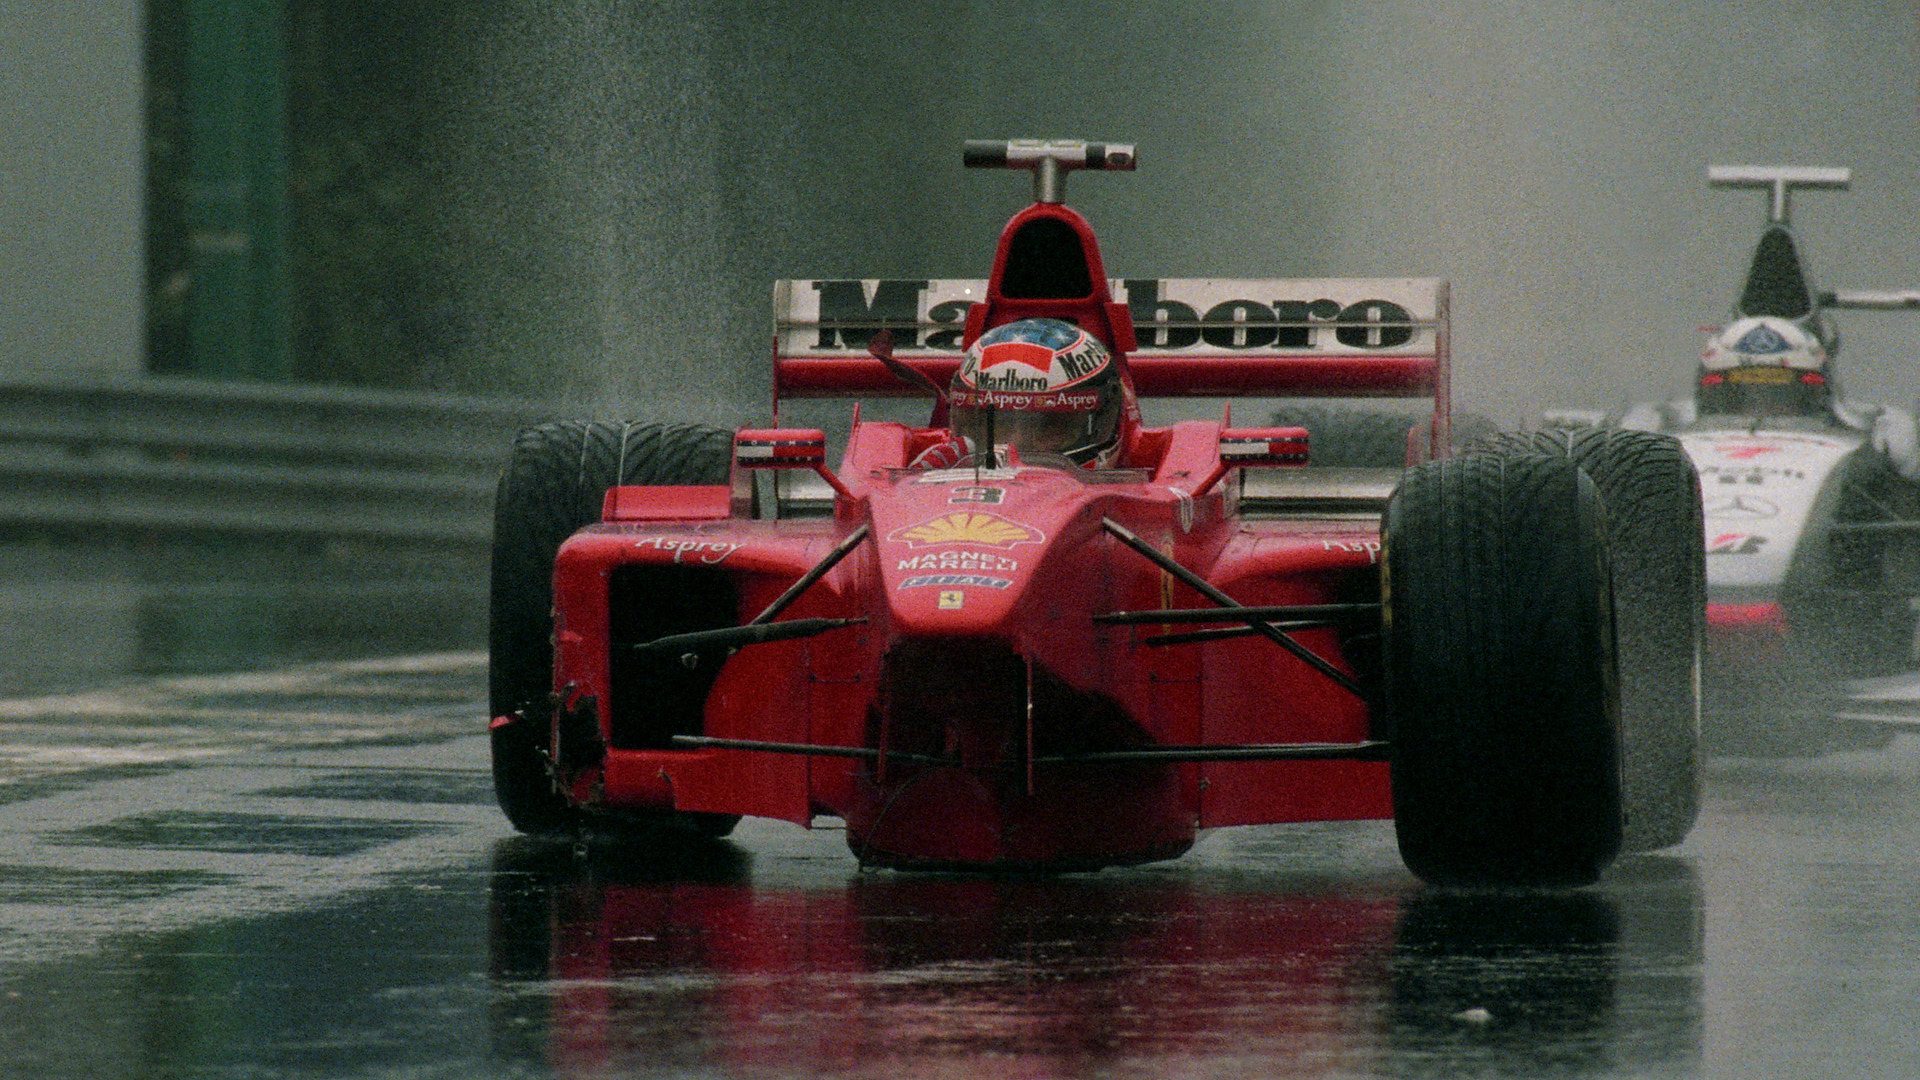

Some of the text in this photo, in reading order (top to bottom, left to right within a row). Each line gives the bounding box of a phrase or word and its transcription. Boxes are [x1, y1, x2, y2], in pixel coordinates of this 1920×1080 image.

[810, 280, 1412, 349] Maboro
[977, 368, 1048, 391] Marlboro
[979, 391, 1033, 409] Asprey
[1054, 392, 1096, 409] Asprey
[635, 537, 747, 564] Asprey
